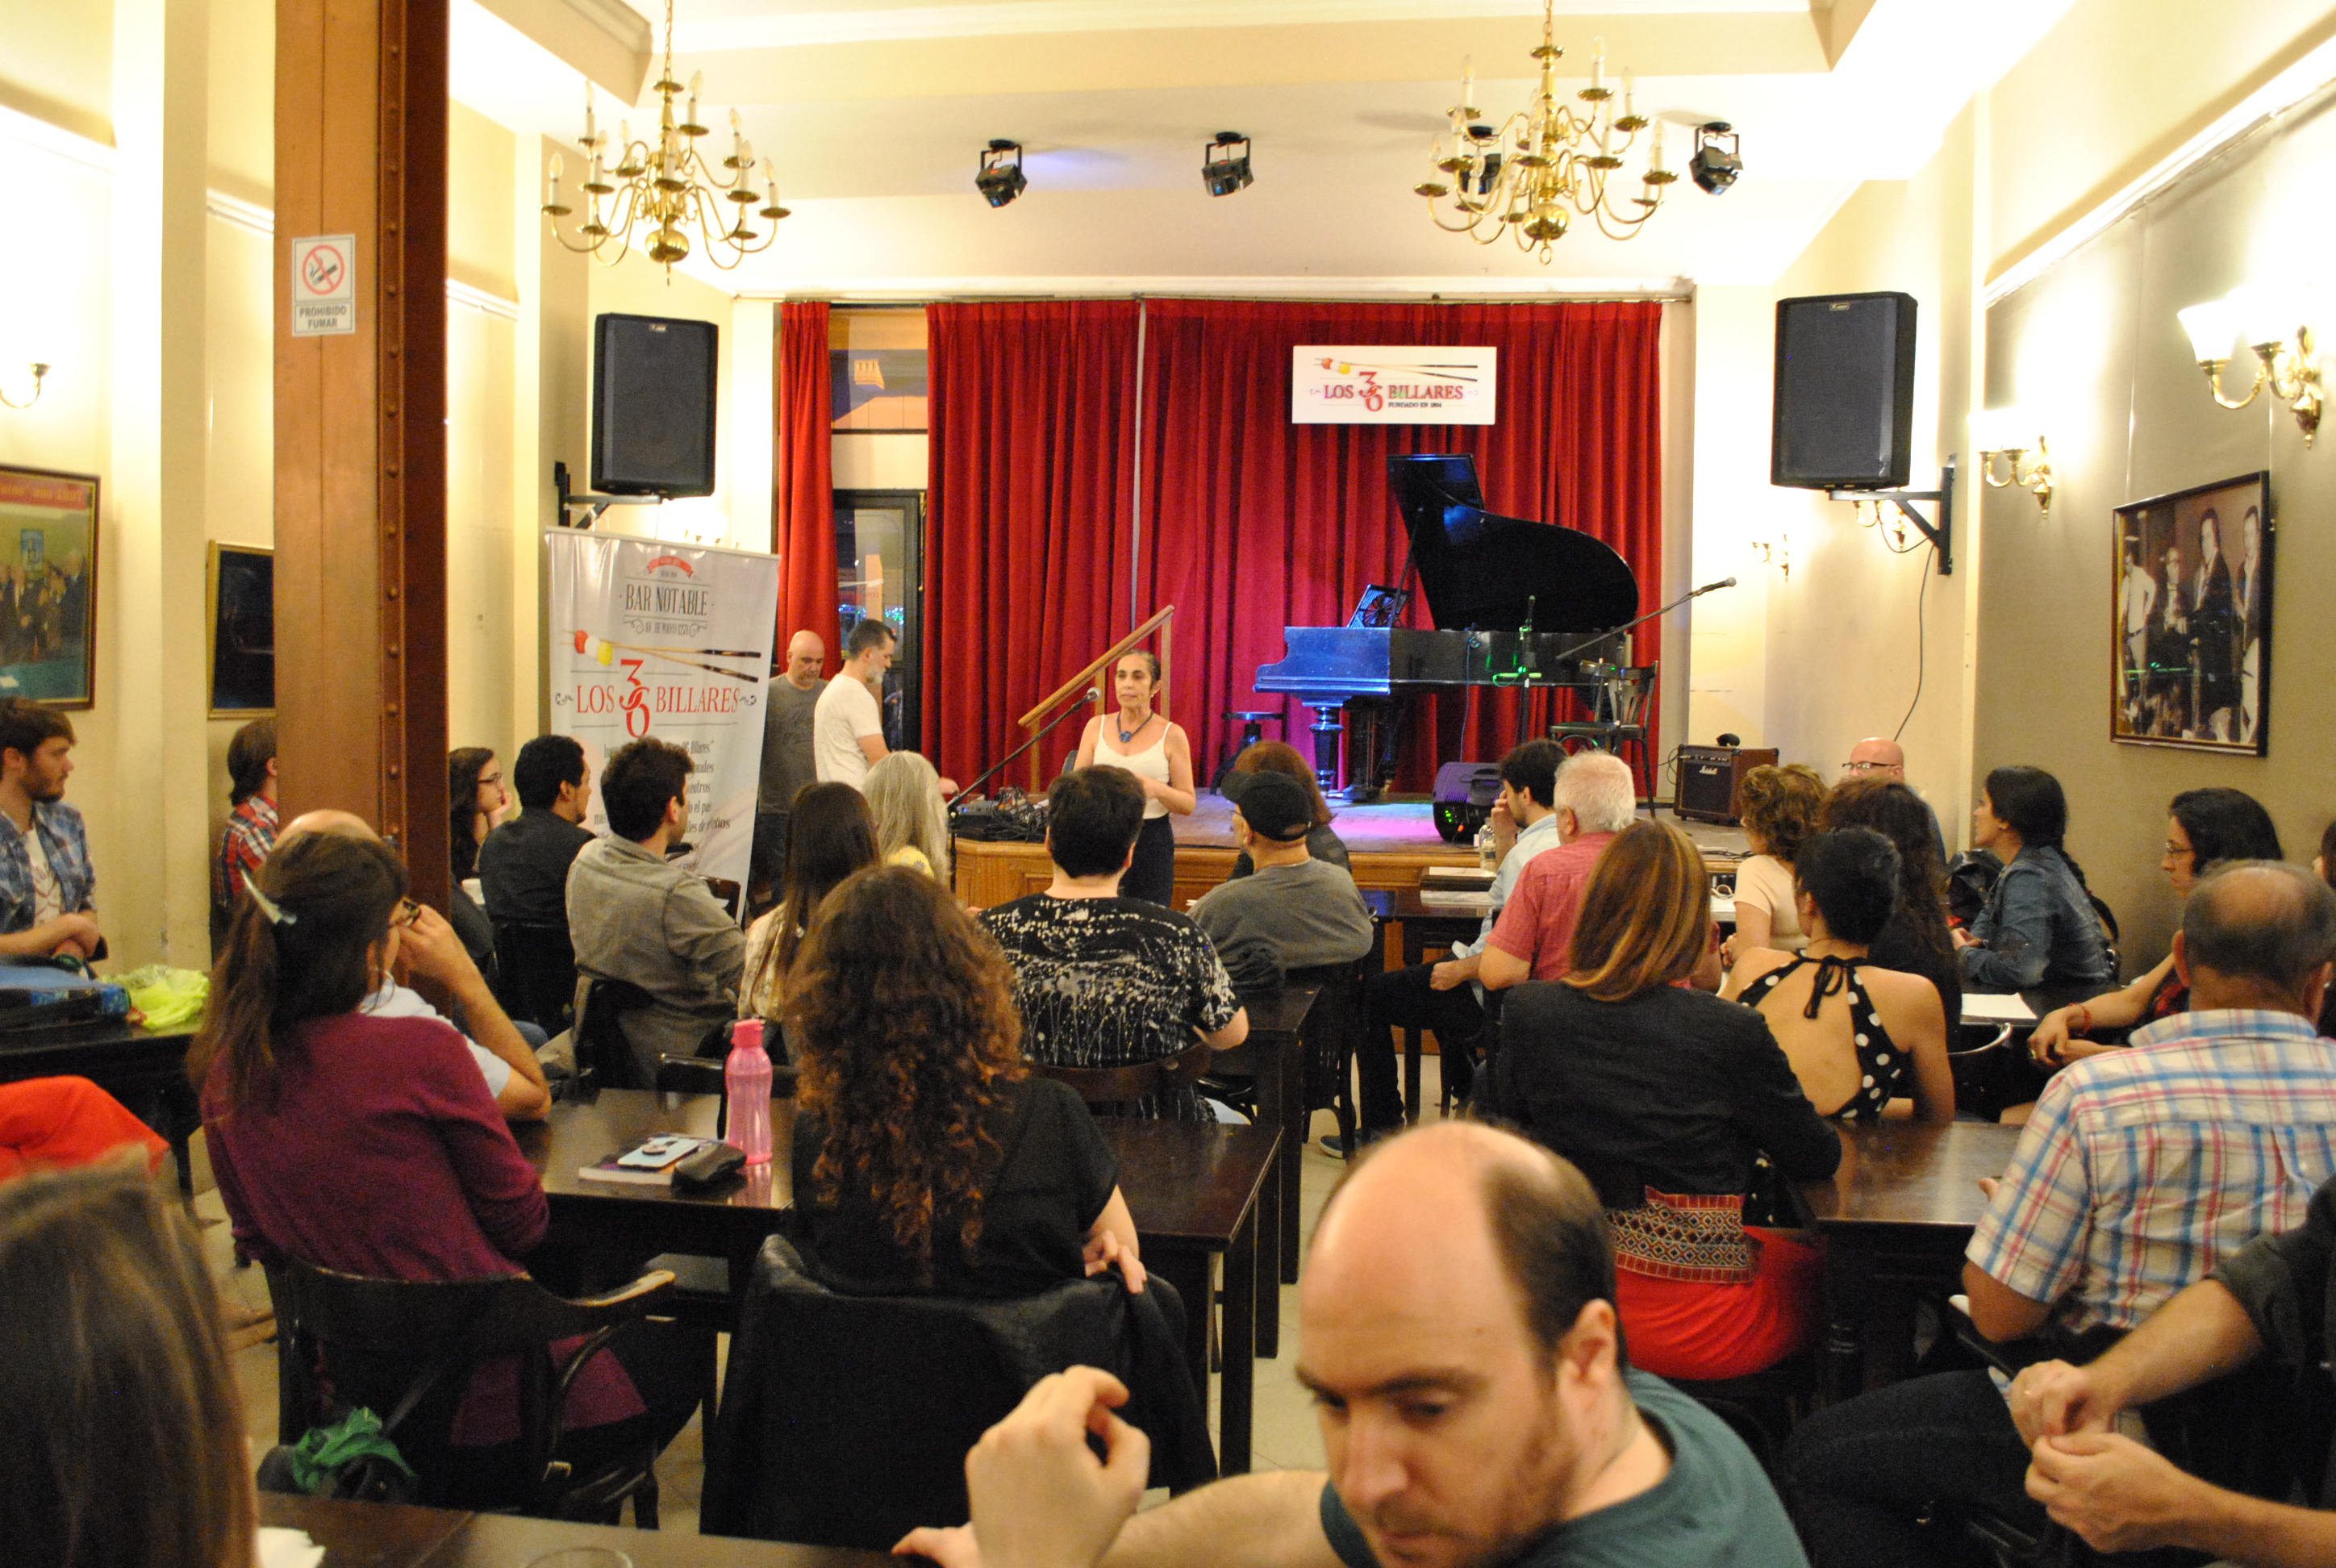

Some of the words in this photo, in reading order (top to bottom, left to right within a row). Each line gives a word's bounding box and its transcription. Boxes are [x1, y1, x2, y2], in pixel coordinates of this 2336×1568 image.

[299, 306, 347, 318] PROHIBIDO
[308, 318, 338, 329] FUMAR
[1324, 385, 1354, 399] LOS
[1388, 385, 1463, 400] BILLARES
[626, 584, 652, 611] BAR
[656, 586, 709, 616] NOTABLE
[576, 685, 615, 714] LOS
[656, 686, 740, 714] BILLARES
